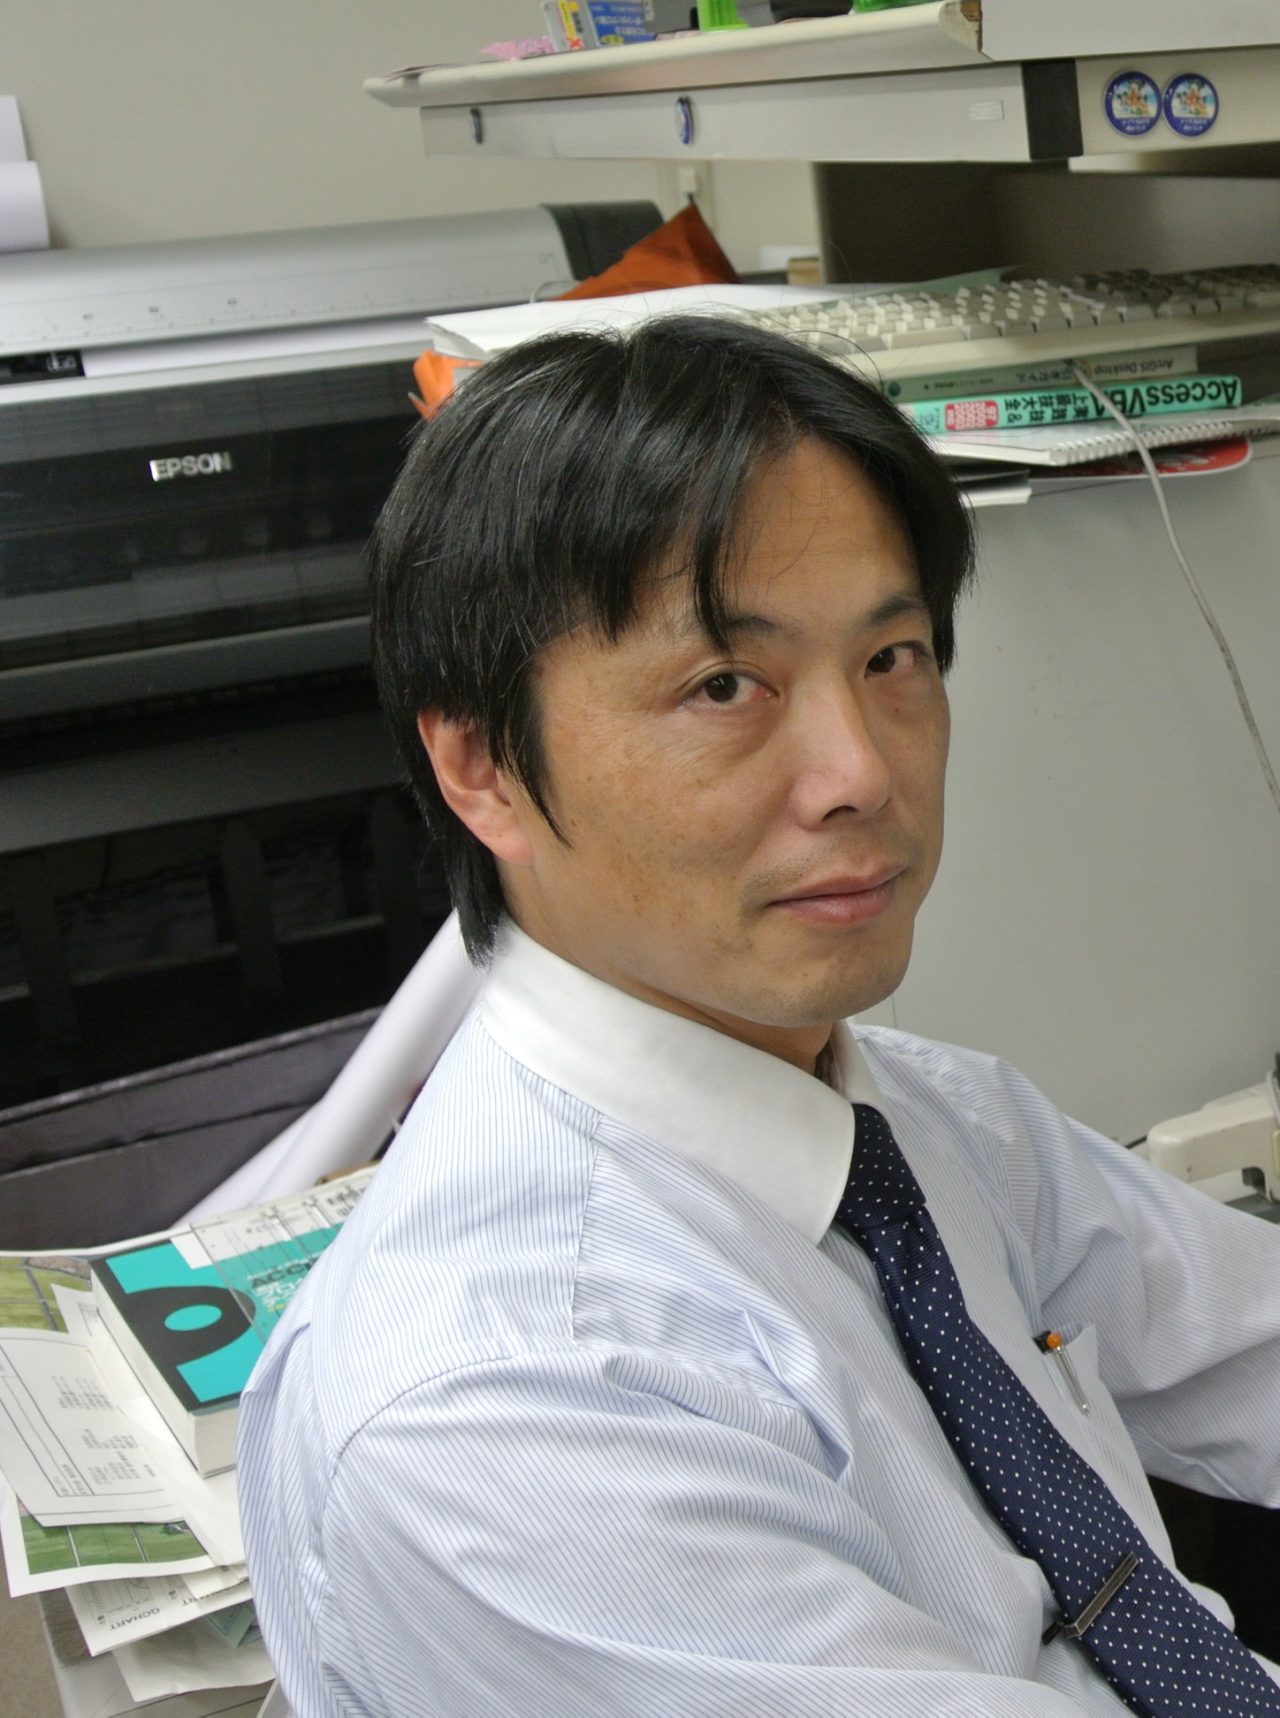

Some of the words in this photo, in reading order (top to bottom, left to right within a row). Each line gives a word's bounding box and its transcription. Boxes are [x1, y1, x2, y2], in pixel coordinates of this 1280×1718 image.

[1094, 359, 1136, 376] Desktop
[1138, 357, 1175, 372] ArcGIS
[149, 452, 232, 481] EPSON
[110, 1607, 160, 1631] GCHART
